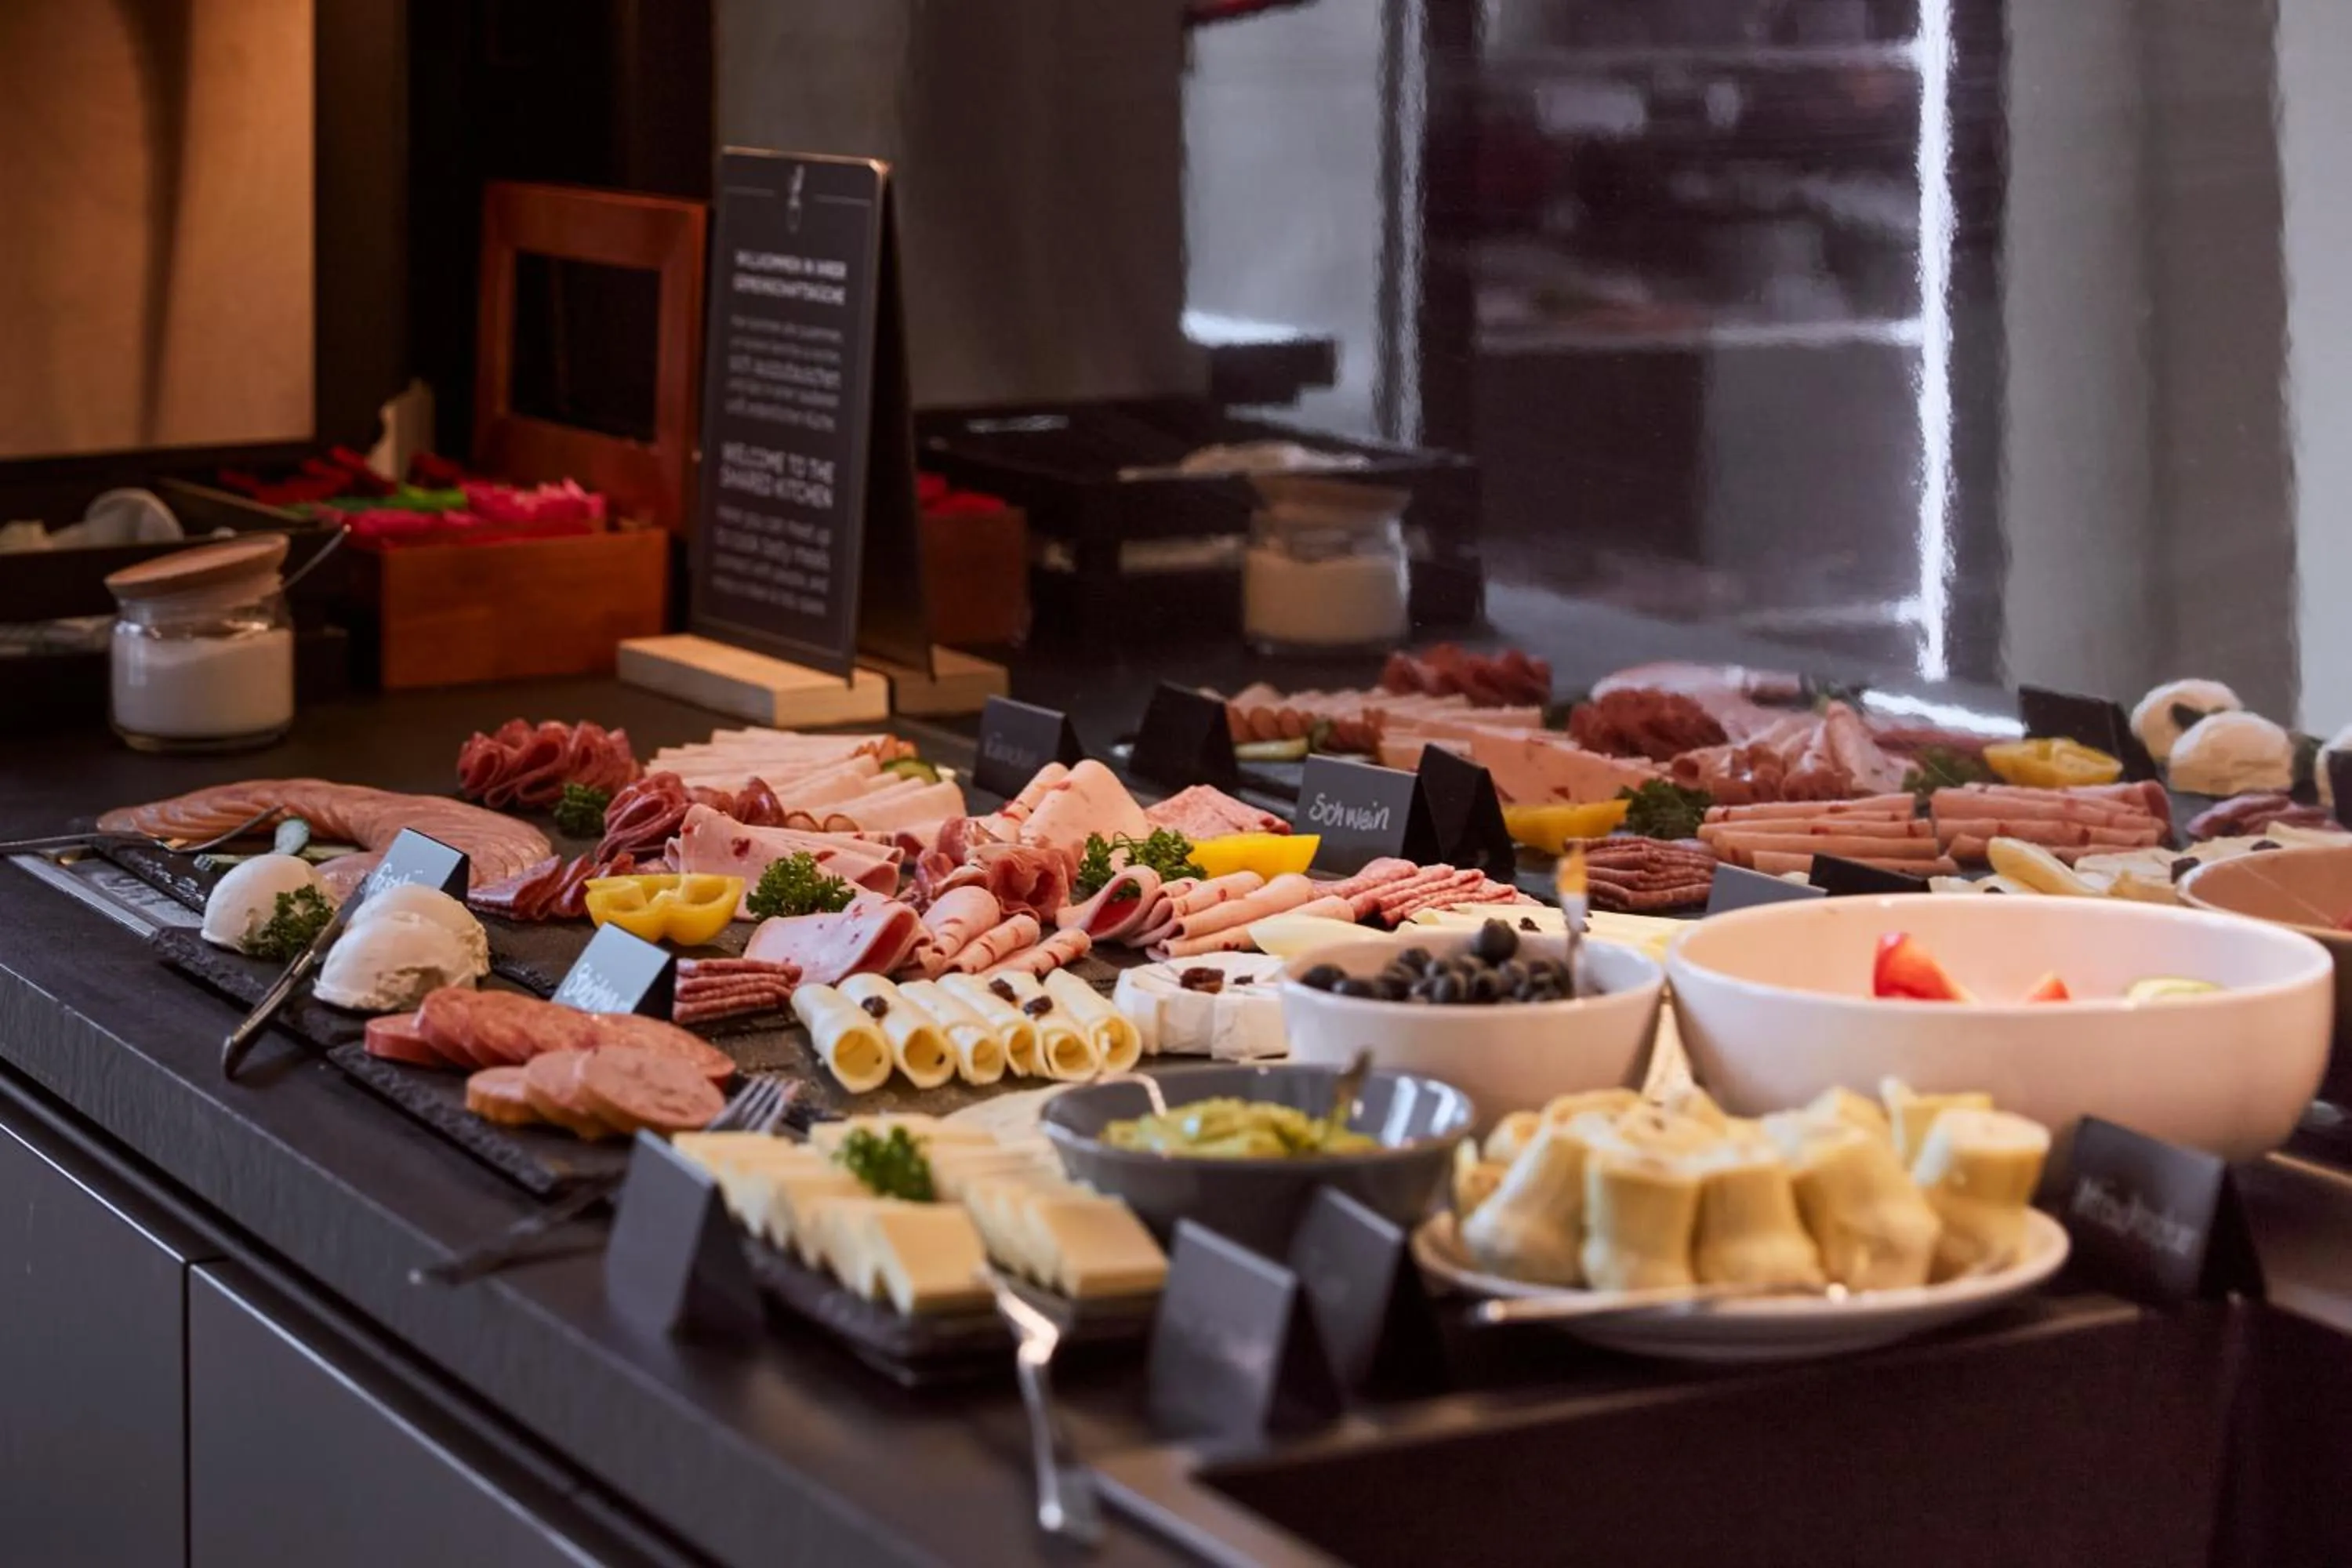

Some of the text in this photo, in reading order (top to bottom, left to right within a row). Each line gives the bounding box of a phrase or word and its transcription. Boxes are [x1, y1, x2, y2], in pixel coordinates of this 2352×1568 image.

[721, 443, 786, 474] WELCOME
[787, 452, 806, 478] TO
[1308, 793, 1390, 831] Schwein
